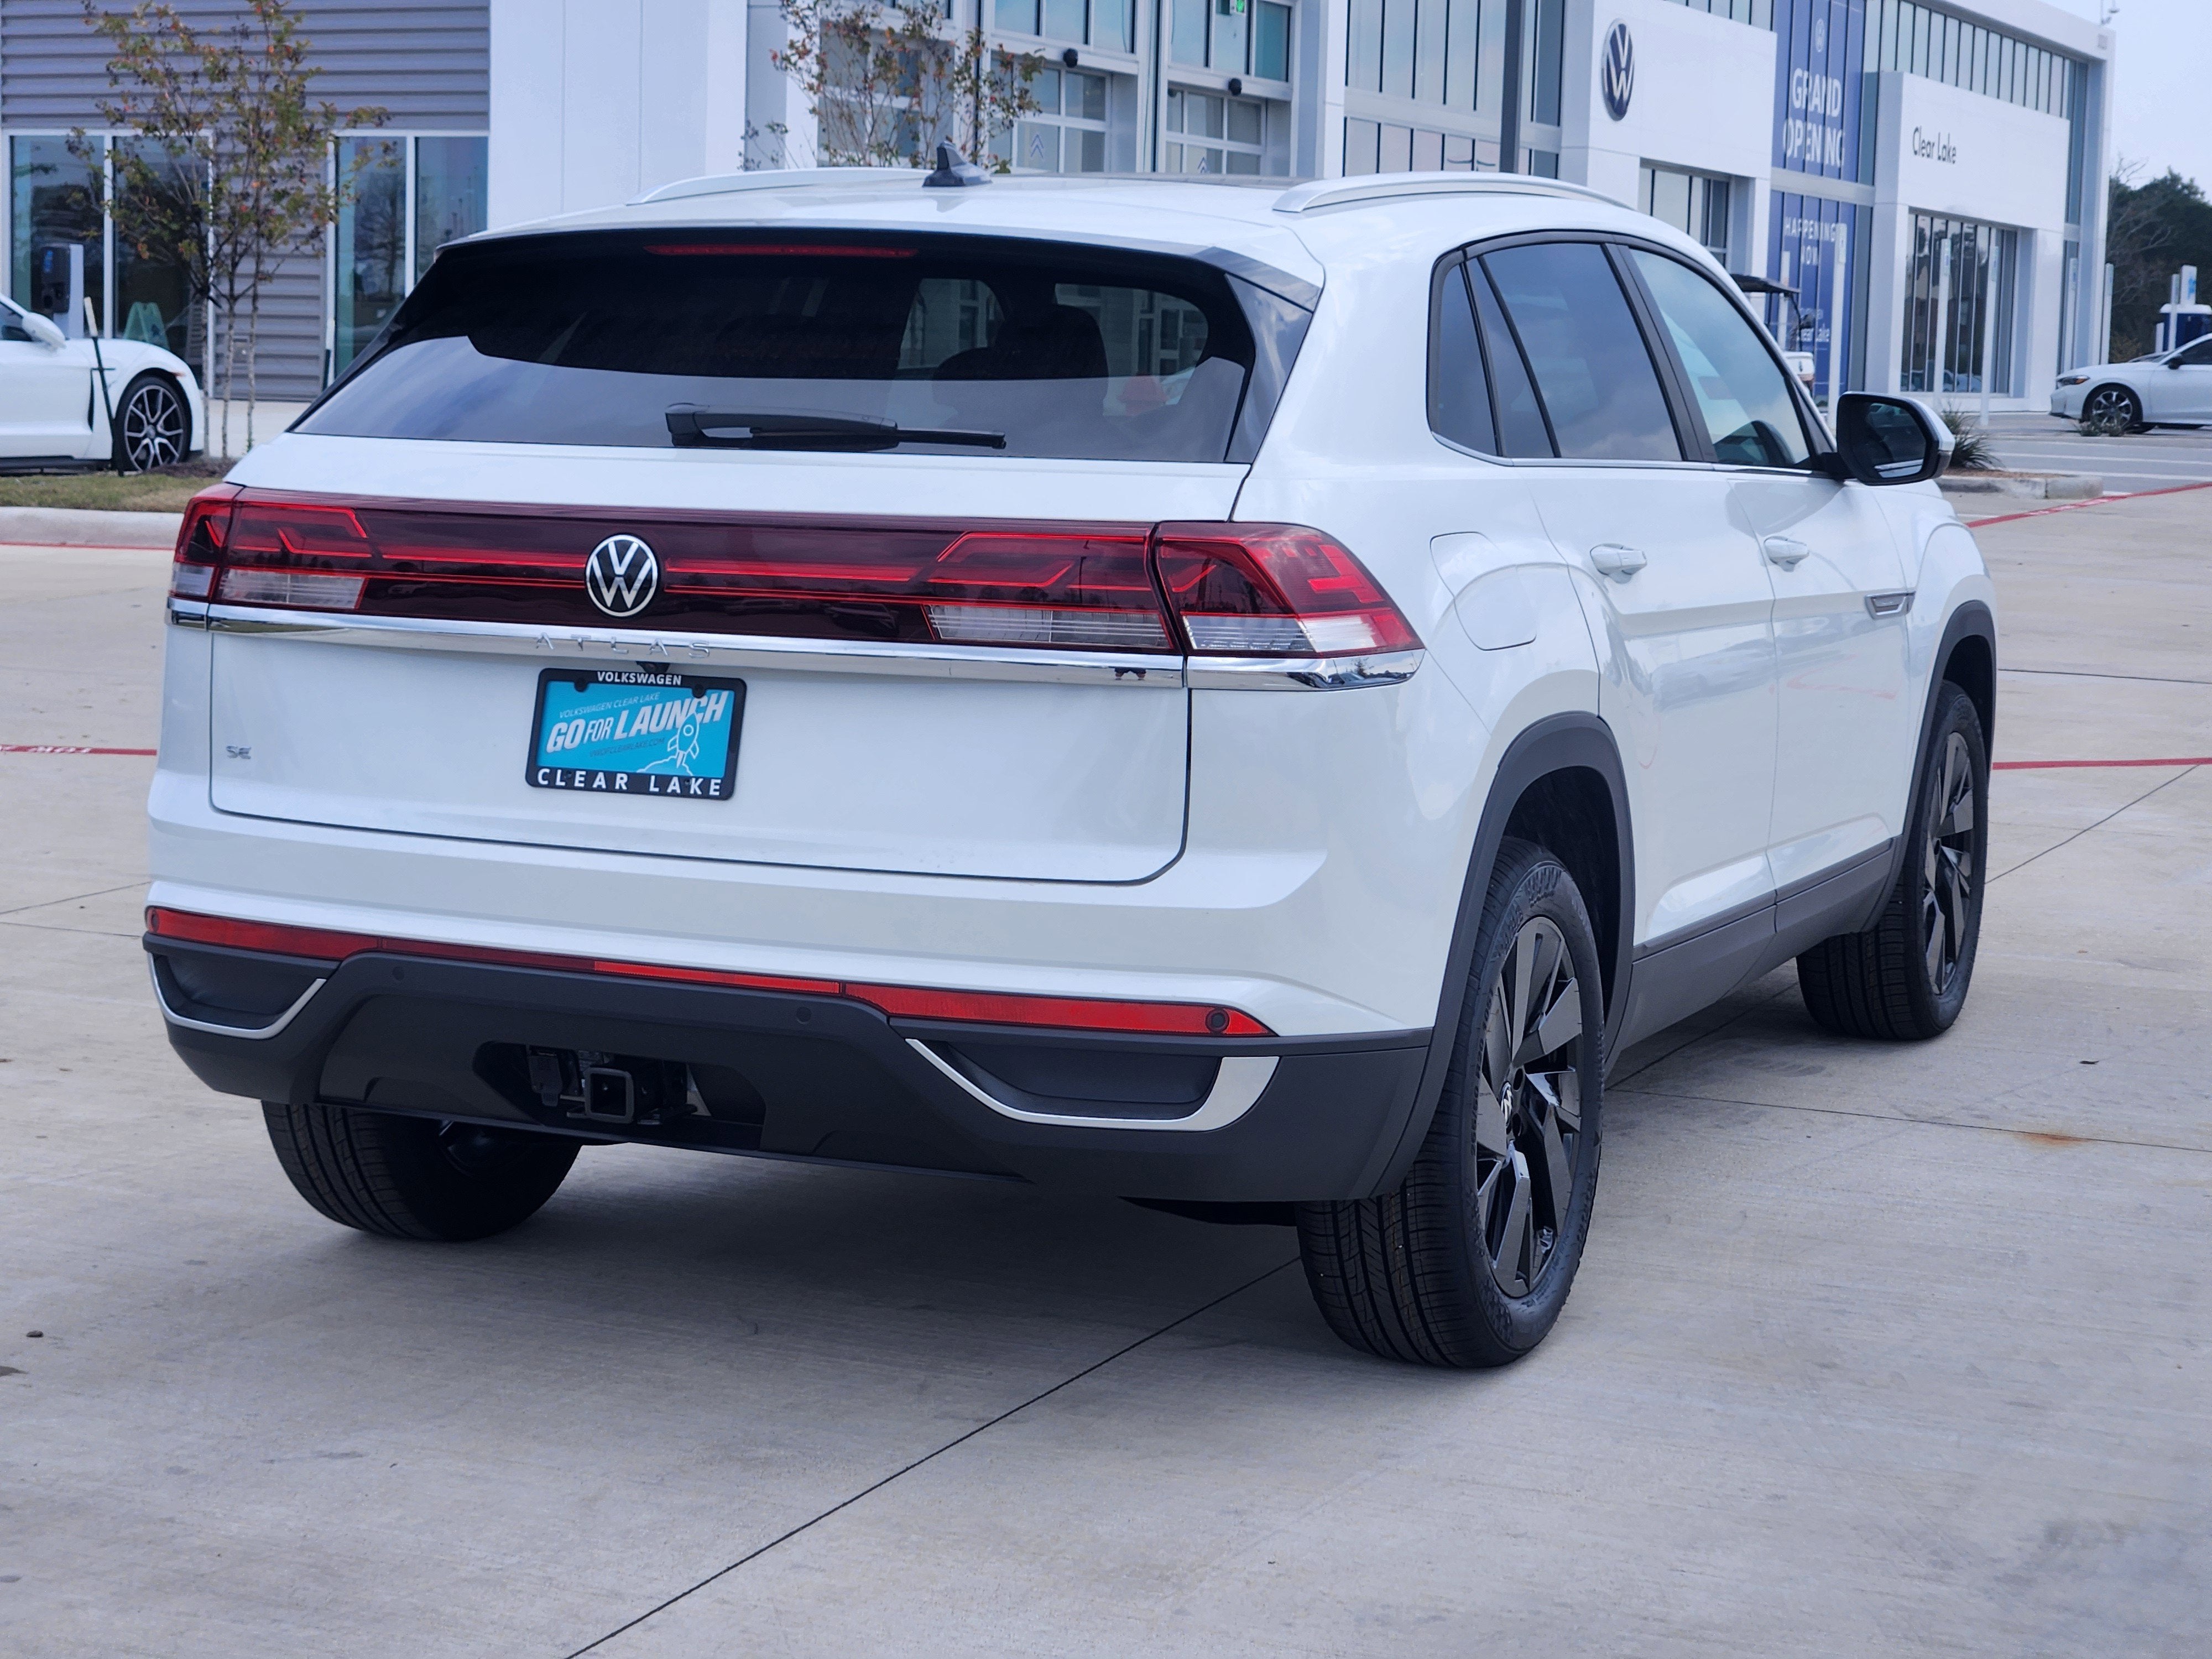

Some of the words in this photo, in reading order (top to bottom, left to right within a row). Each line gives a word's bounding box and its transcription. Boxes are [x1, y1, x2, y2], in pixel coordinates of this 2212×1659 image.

[1792, 67, 1841, 117] GRAND
[1913, 126, 1934, 159] Clear
[1937, 132, 1956, 164] Lake
[536, 632, 709, 658] ATLAS
[597, 671, 682, 686] VOLKSWAGEN
[560, 702, 611, 718] VOLKSWAGEN
[613, 696, 639, 708] CLEAR
[639, 692, 660, 703] LAKE
[546, 718, 586, 754] GO
[583, 717, 614, 744] FOR
[613, 691, 729, 740] LAUNCH
[226, 745, 252, 759] SE
[538, 768, 628, 790] CLEAR
[649, 775, 722, 796] LAKE
